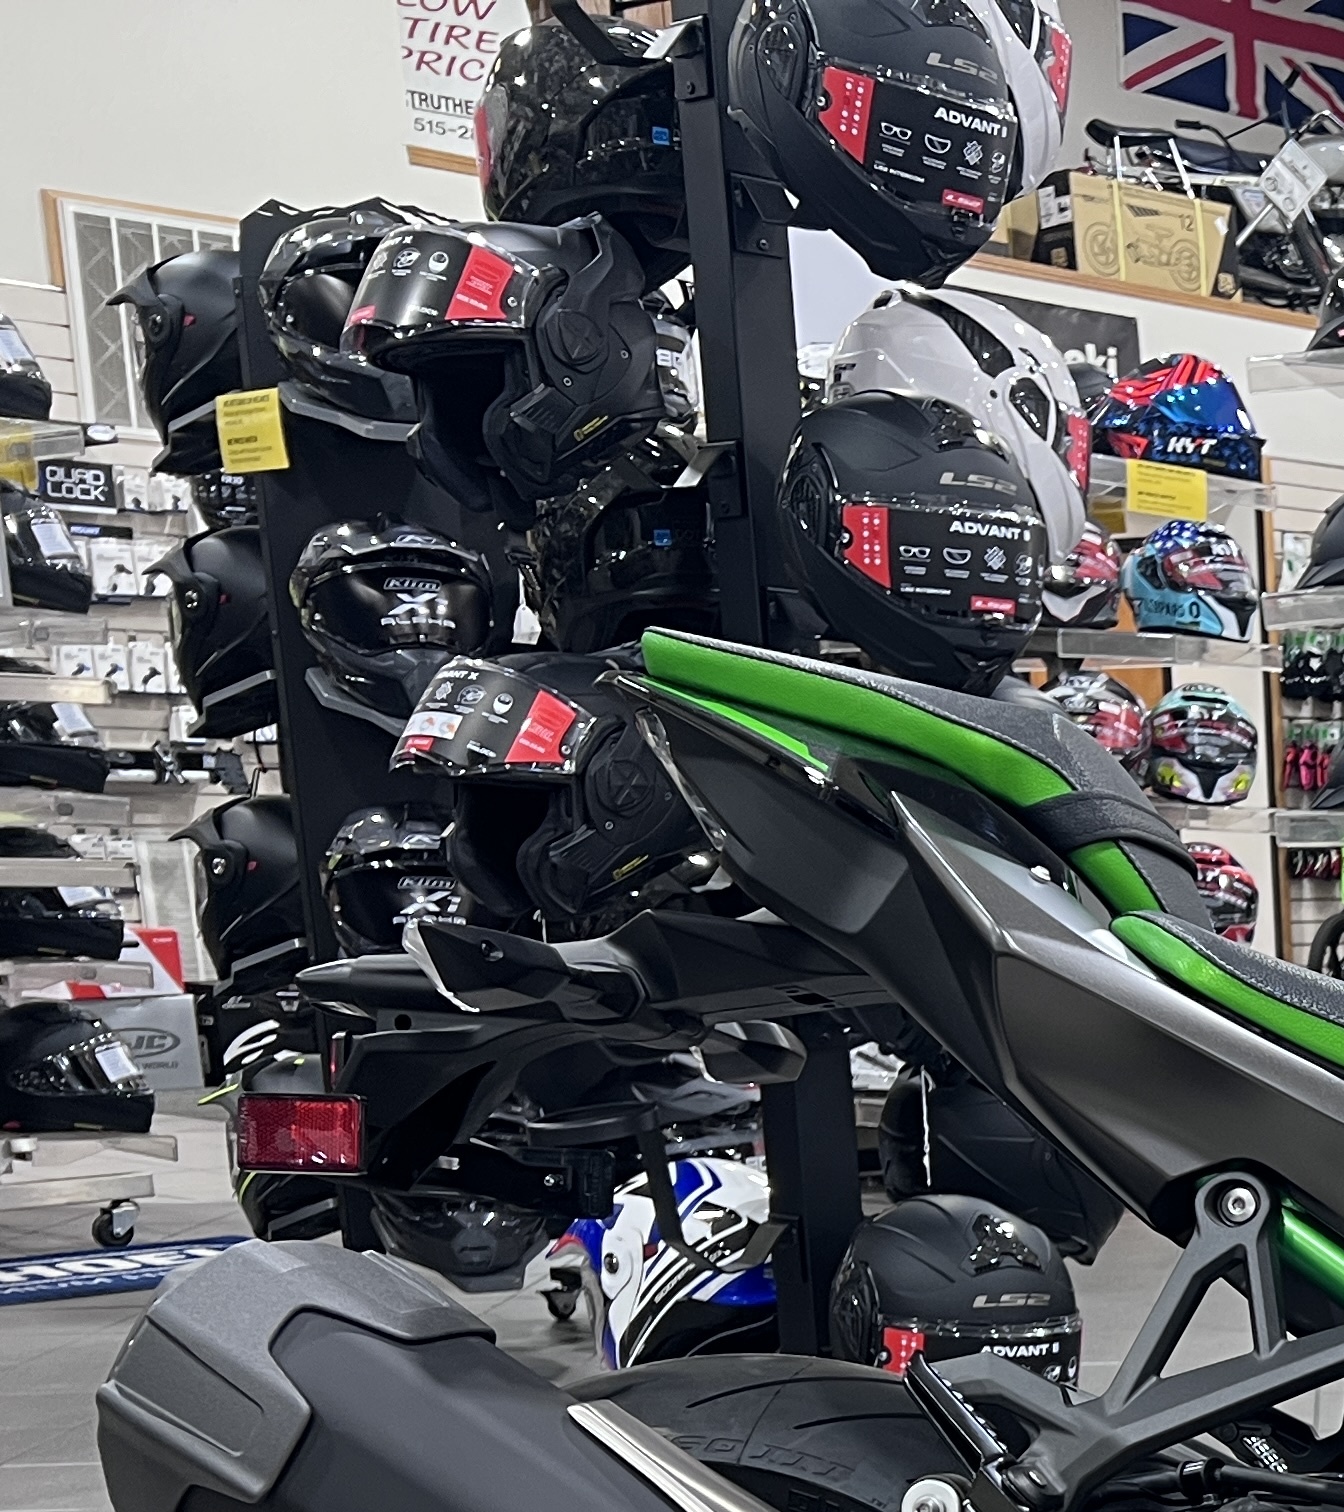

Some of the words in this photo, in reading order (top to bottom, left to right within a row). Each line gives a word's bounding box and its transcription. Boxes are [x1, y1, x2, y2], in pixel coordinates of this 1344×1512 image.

[397, 0, 496, 20] OW
[403, 17, 499, 53] TIRE
[926, 52, 999, 83] LS2
[407, 90, 474, 116] TRUTHE
[413, 117, 474, 141] 515-2
[934, 107, 1000, 137] ADVANT
[1166, 436, 1218, 455] KYT
[45, 465, 105, 486] QUAD
[939, 472, 1018, 496] LS2
[46, 481, 107, 502] LOCK
[950, 521, 1021, 540] ADVANT
[972, 1293, 1051, 1309] LS2
